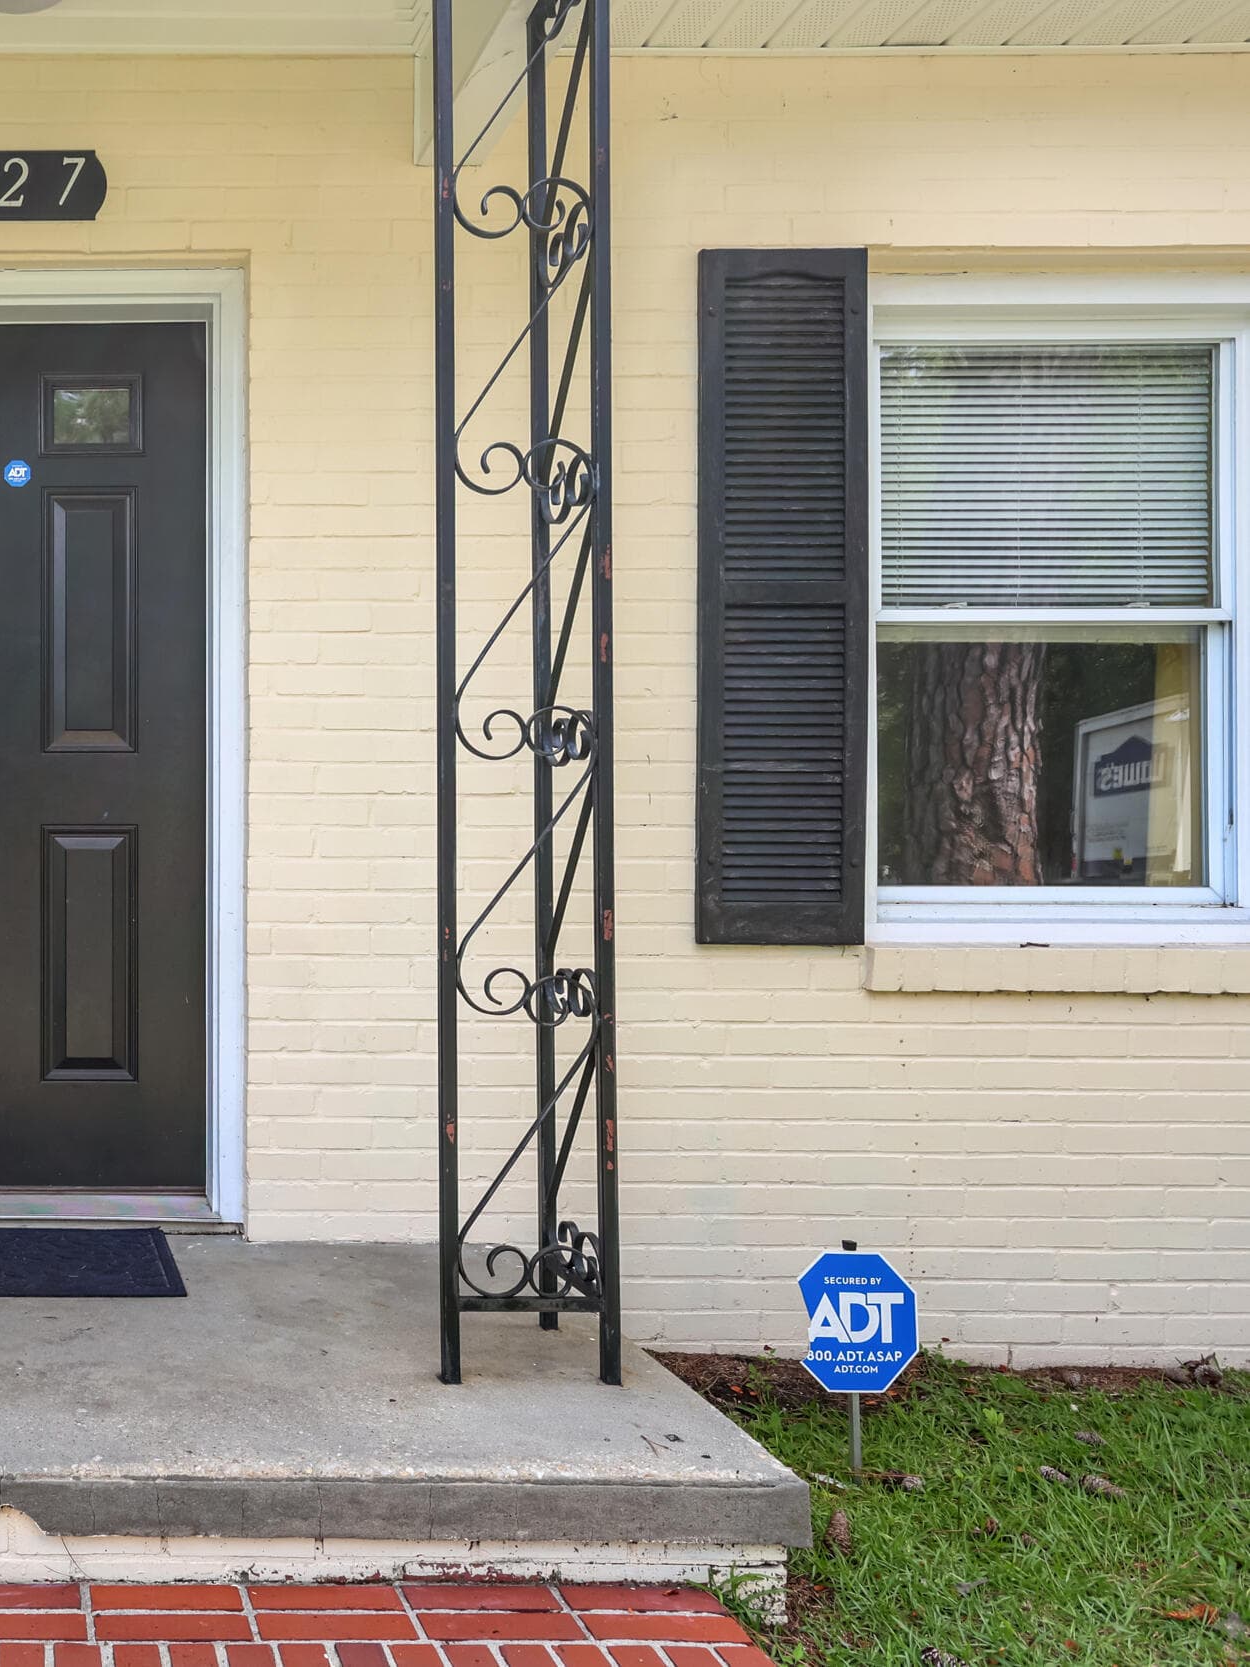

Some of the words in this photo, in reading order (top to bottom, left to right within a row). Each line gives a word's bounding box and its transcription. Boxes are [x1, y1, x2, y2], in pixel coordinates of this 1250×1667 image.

[8, 467, 27, 477] ADT
[824, 1276, 868, 1285] SECURED
[870, 1277, 882, 1285] BY
[808, 1292, 904, 1343] ADT
[807, 1350, 903, 1362] 800.ADT.ASAP
[834, 1365, 879, 1374] ADT.COM
